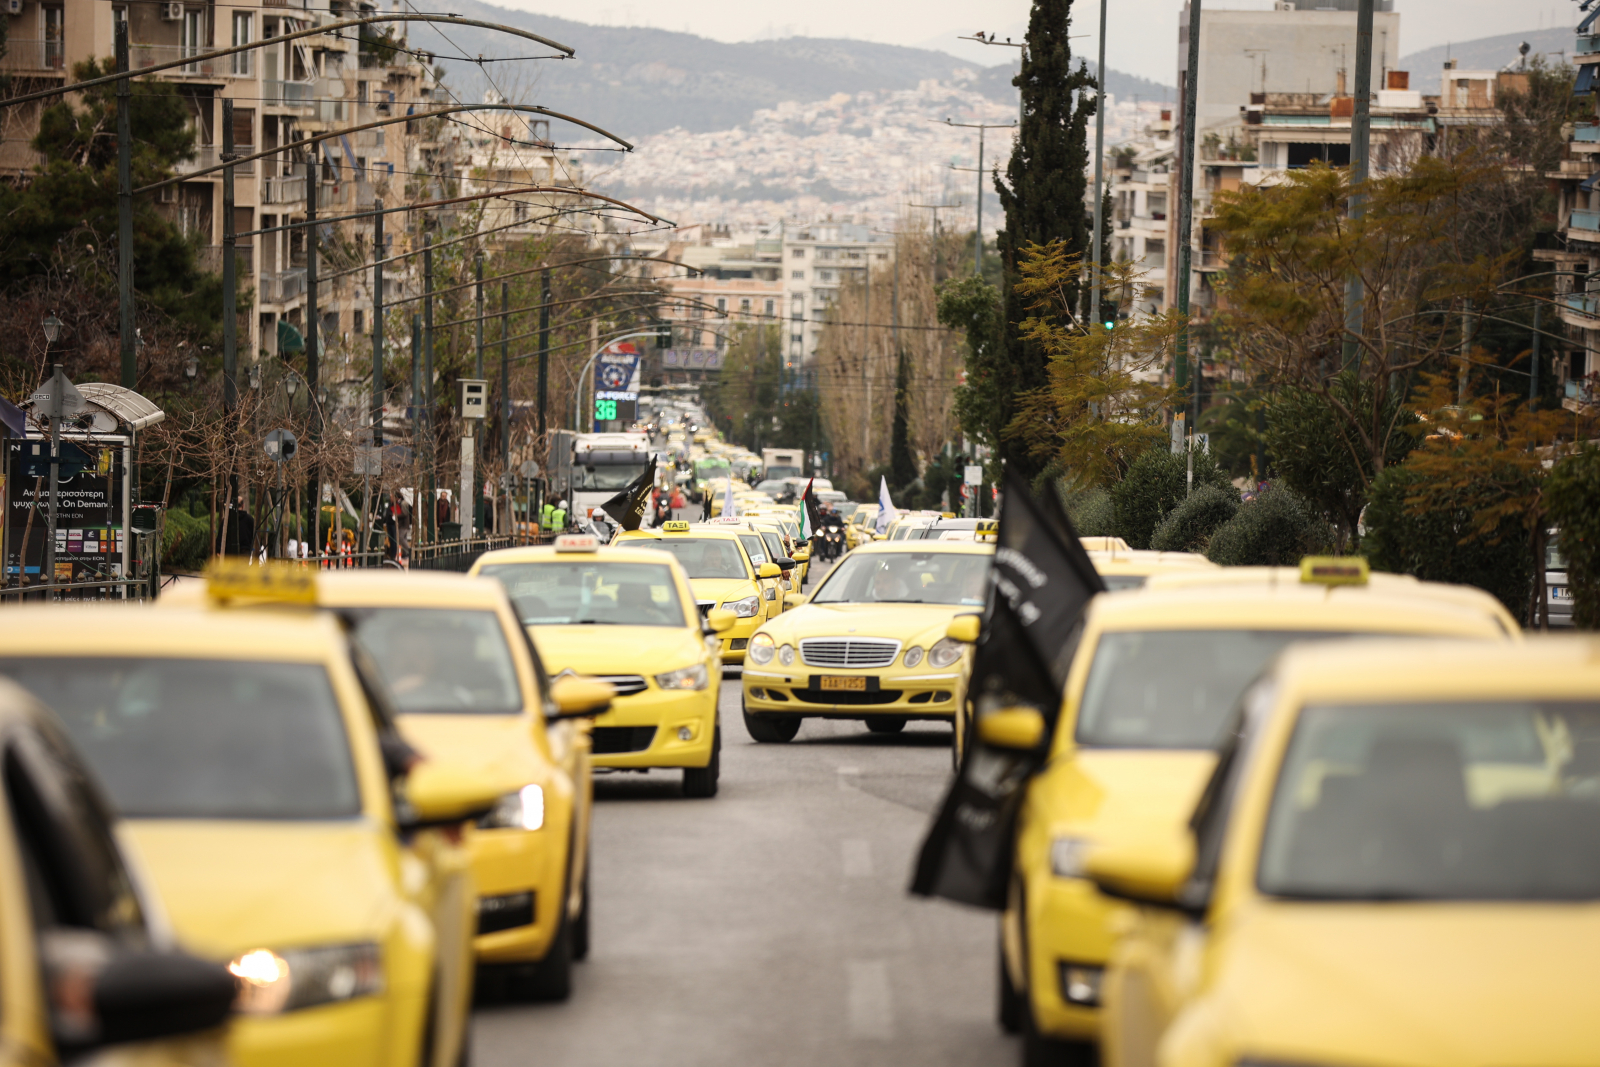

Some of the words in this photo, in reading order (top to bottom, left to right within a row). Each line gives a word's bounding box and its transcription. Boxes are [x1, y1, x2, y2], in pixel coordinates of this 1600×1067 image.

[22, 489, 49, 499] Ακμα
[57, 489, 104, 499] ερισσότερη
[63, 500, 76, 508] On
[78, 500, 114, 508] Deman.
